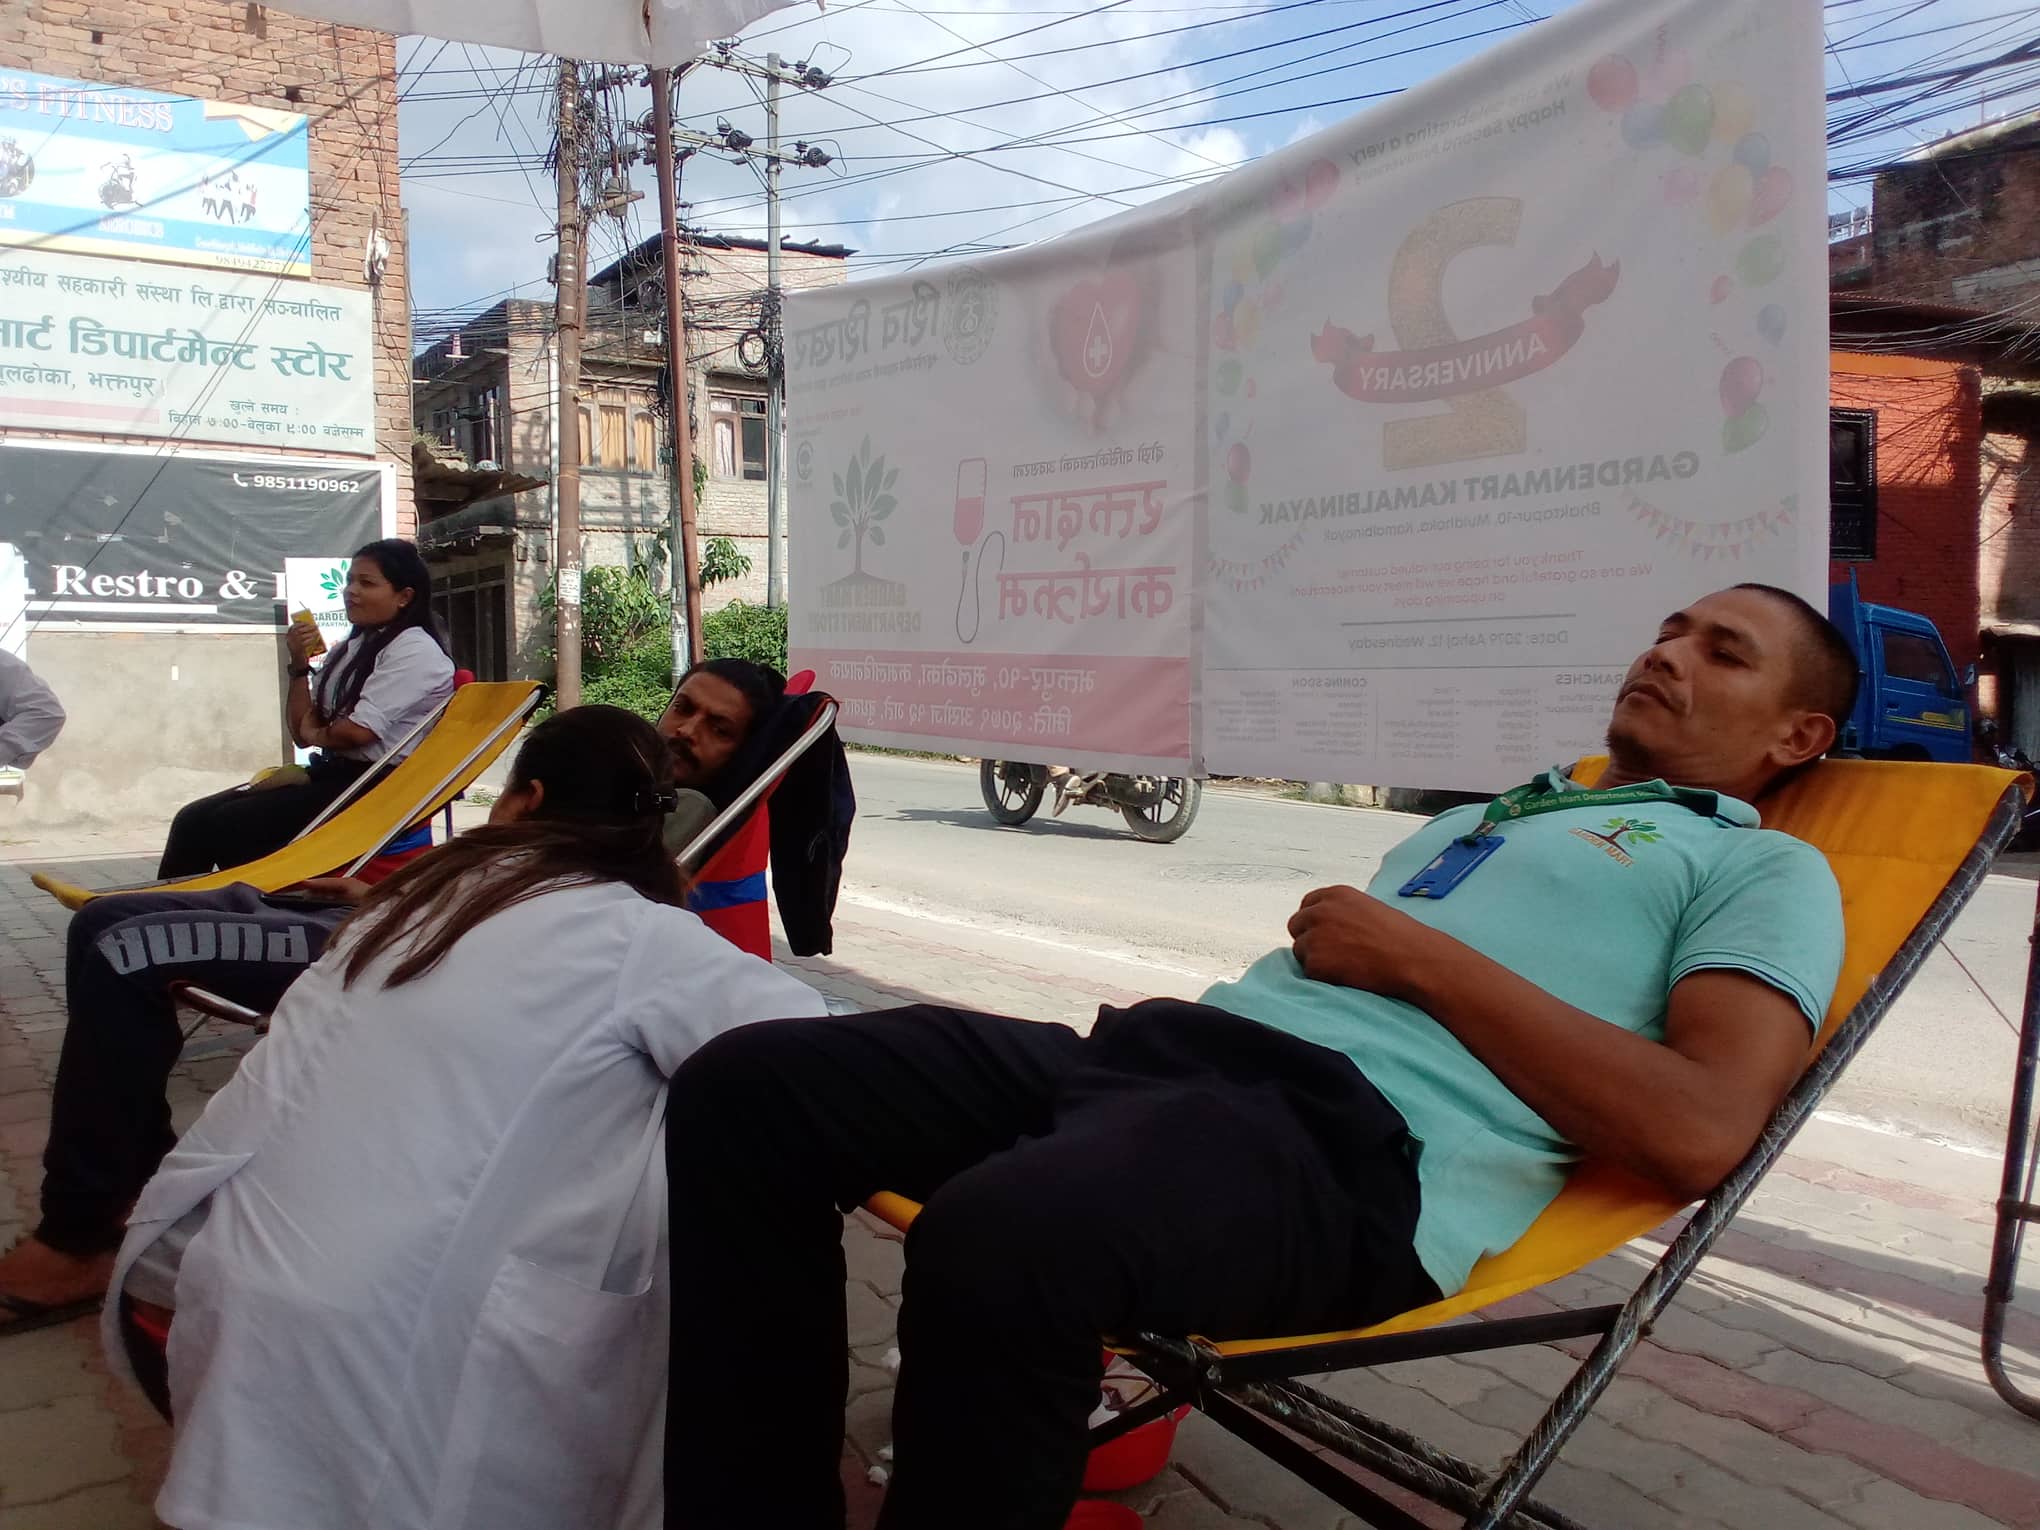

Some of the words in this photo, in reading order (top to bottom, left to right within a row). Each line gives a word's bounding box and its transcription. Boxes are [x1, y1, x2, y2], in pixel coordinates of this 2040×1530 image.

[39, 82, 174, 133] FITNESS
[57, 276, 128, 300] सहकारी
[136, 281, 183, 305] संस्था
[69, 316, 258, 371] डिपार्टमेन्ट
[270, 340, 353, 381] स्टोर
[88, 372, 157, 398] भक्तपुर
[252, 475, 360, 493] 9851190962
[51, 564, 204, 601] Restro
[219, 569, 258, 600] &
[96, 920, 310, 976] PUMA
